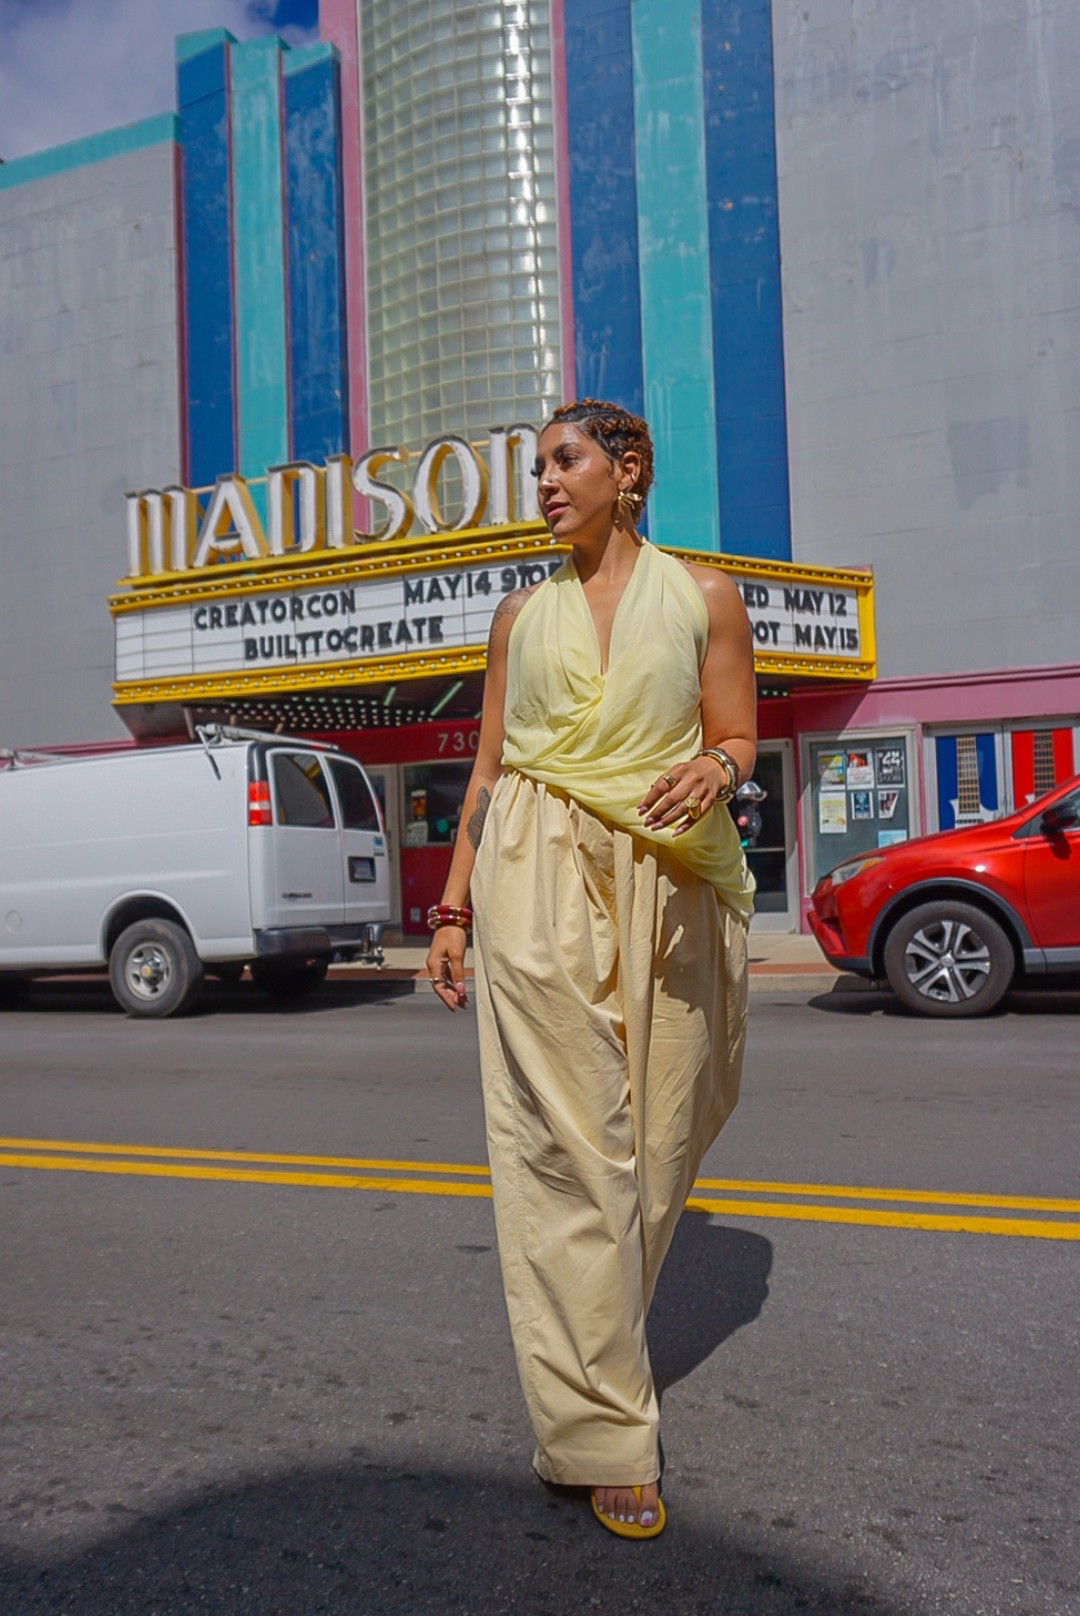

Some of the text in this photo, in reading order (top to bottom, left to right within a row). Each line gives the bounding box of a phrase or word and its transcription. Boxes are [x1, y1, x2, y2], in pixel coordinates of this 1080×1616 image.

[124, 423, 541, 577] MADISON
[736, 583, 769, 609] ED
[750, 621, 780, 646] OT
[437, 731, 479, 752] 730
